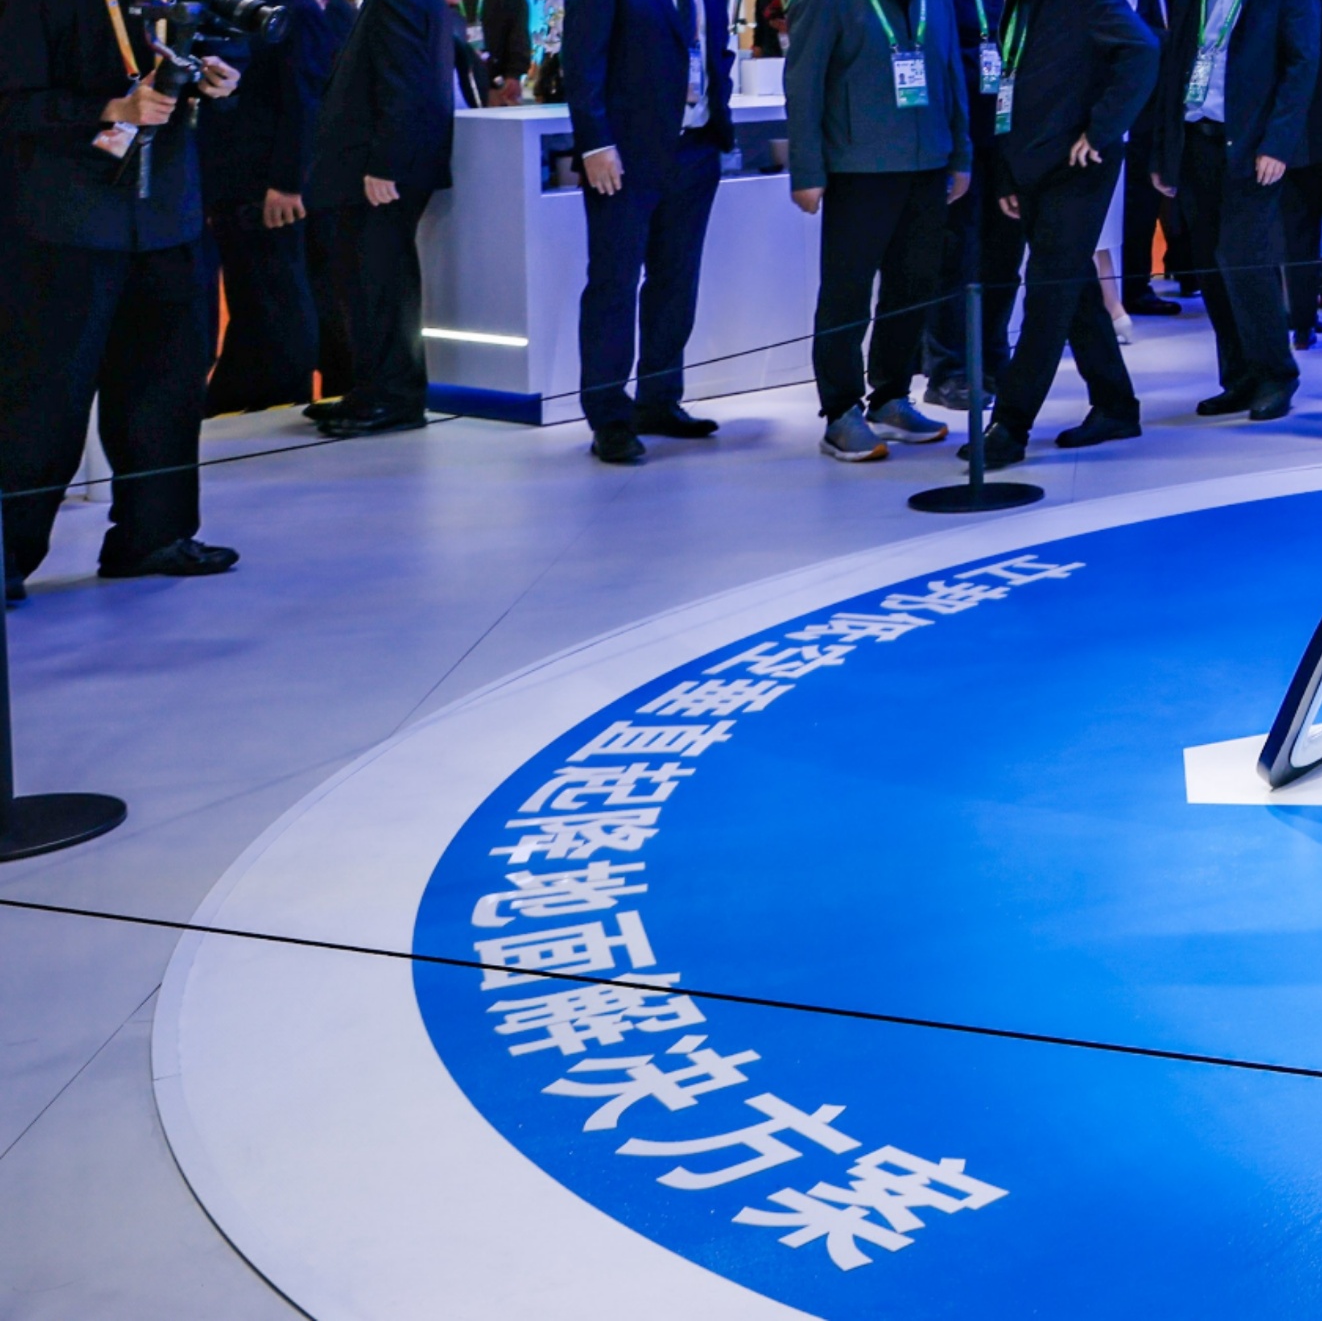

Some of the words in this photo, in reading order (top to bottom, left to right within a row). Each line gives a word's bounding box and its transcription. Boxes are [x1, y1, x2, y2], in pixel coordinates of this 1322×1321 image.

[471, 553, 1087, 1272] 立邦低空垂直起降地面解决方案
